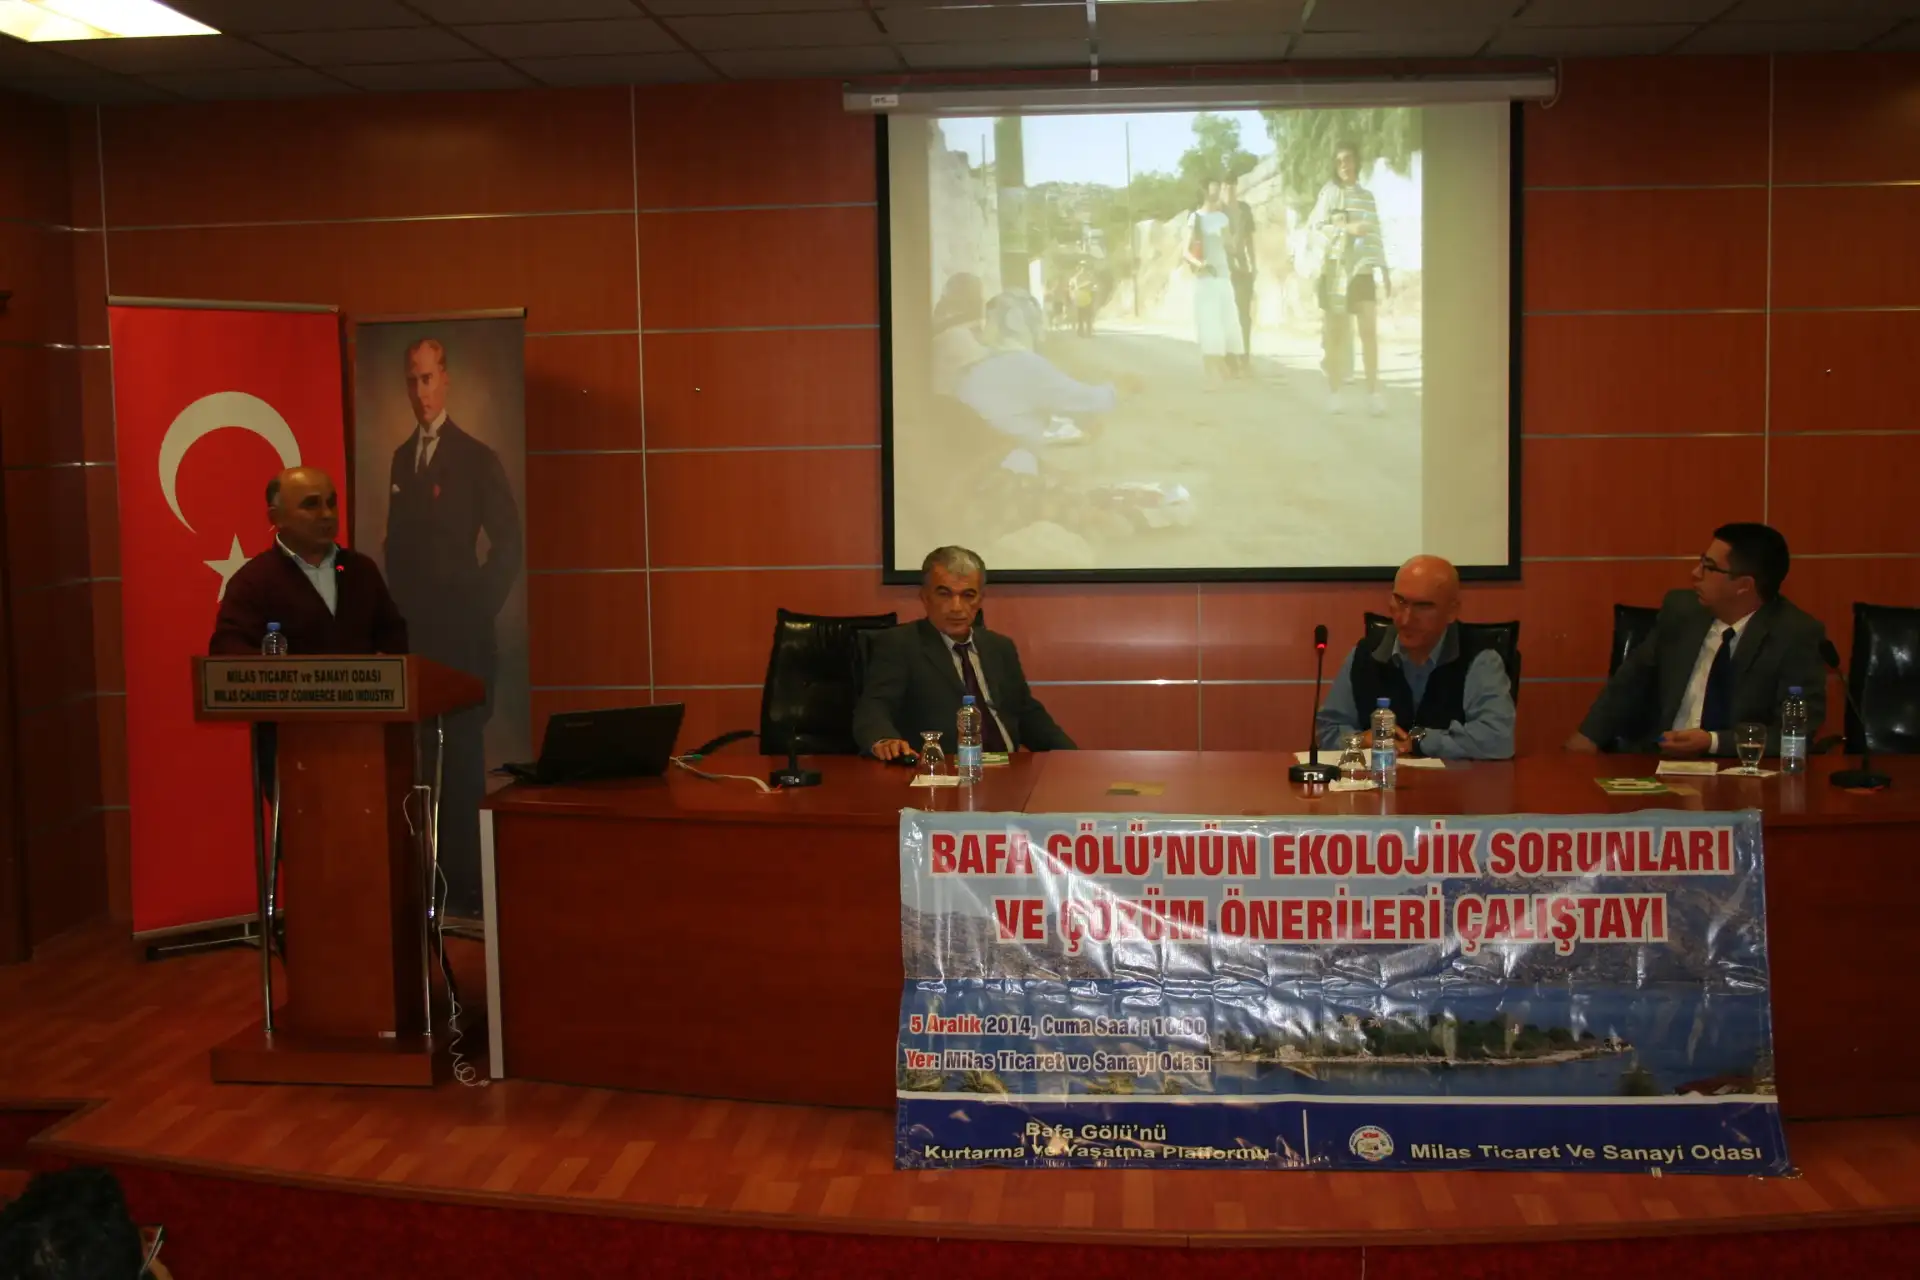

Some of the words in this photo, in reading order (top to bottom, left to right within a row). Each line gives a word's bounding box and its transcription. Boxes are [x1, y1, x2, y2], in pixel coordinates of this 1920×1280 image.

[351, 669, 381, 683] ODASI
[279, 689, 290, 702] OF
[931, 833, 1034, 875] BAFA
[1046, 822, 1257, 877] GÖLÜ'NÜN
[1273, 821, 1477, 875] EKOLOJİK
[1490, 830, 1731, 875] SORUNLARI
[995, 898, 1044, 940] VE
[1220, 886, 1441, 941] ÖNERİLERİ
[1456, 896, 1664, 952] ÇALIŞTAYI
[910, 1015, 923, 1034] 5
[927, 1015, 982, 1034] Aralık
[986, 1015, 1037, 1038] 2014,
[1043, 1016, 1093, 1035] Cuma
[1096, 1016, 1139, 1035] Saat
[905, 1050, 940, 1069] Yer:
[946, 1051, 995, 1070] Milas
[998, 1051, 1064, 1071] Ticaret
[1068, 1055, 1090, 1071] ve
[1094, 1051, 1156, 1075] Sanayi
[1160, 1052, 1211, 1072] Odası
[1025, 1121, 1074, 1139] Bafa
[924, 1144, 1025, 1160] Kurtarma
[1066, 1143, 1156, 1159] Yaşatma
[1410, 1143, 1472, 1160] Milas
[1477, 1144, 1562, 1160] Ticaret
[1565, 1143, 1597, 1160] Ve
[1602, 1144, 1685, 1165] Sanayi
[1691, 1144, 1763, 1161] Odası
